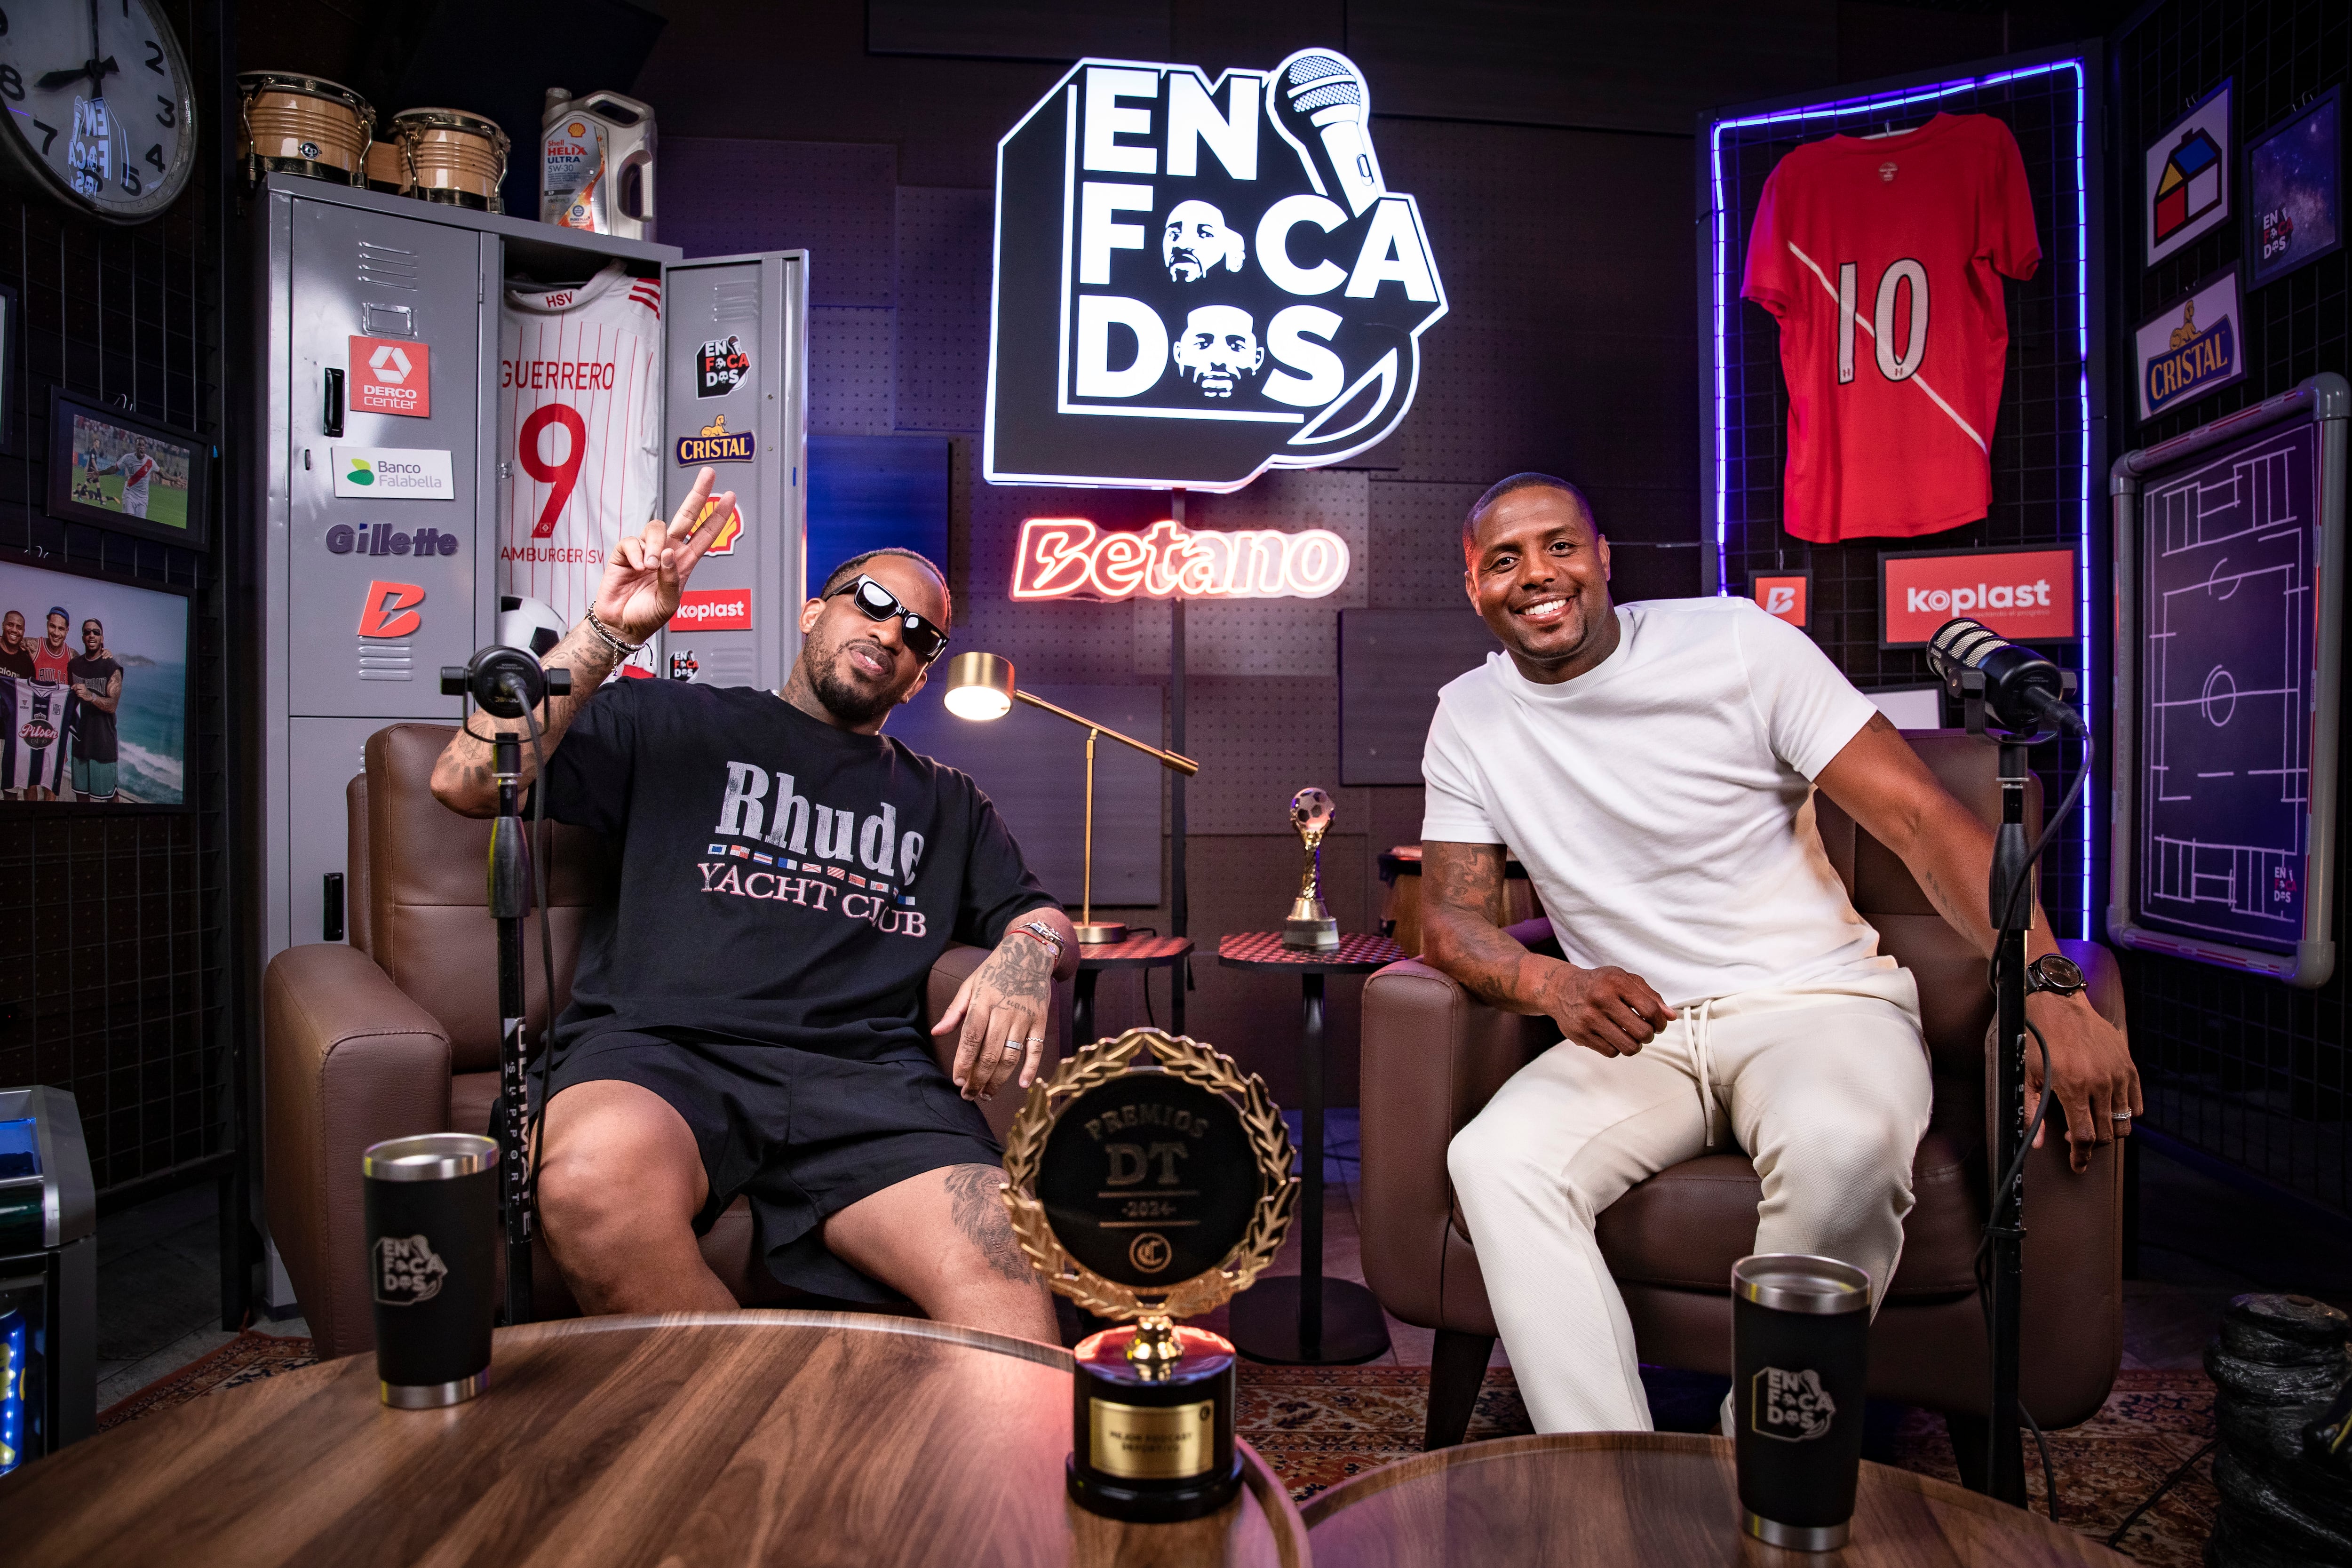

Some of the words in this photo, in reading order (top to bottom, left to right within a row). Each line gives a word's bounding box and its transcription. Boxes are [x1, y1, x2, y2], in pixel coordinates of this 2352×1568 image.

[144, 40, 165, 76] 2
[0, 64, 25, 101] 8
[156, 94, 175, 128] 3
[1083, 67, 1259, 180] EN
[33, 119, 58, 155] 7
[548, 143, 588, 156] HELIX
[145, 143, 166, 174] 4
[548, 164, 574, 173] 5W-30
[121, 162, 142, 197] 5
[546, 291, 573, 308] HSV
[1838, 258, 1930, 384] 10
[706, 341, 727, 357] EN
[502, 360, 614, 390] GUERRERO
[2151, 333, 2228, 400] CRISTAL
[364, 385, 417, 399] DERCO
[364, 396, 417, 409] center
[681, 437, 750, 460] CRISTAL
[378, 461, 421, 474] Banco
[379, 475, 442, 488] Falabella
[519, 404, 586, 538] 9
[326, 523, 458, 555] Gillette
[501, 547, 583, 563] AMBURGER
[1012, 517, 1347, 597] Betano
[676, 601, 744, 621] koplast
[1907, 579, 2050, 617] koplast
[675, 652, 687, 660] EN
[19, 724, 58, 739] Pilsen
[715, 761, 925, 886] Rhude
[697, 862, 837, 911] YACHT
[842, 893, 927, 938] CLUB
[509, 1061, 520, 1204] SUPPORT
[1084, 1104, 1209, 1142] PREMIOS
[1104, 1143, 1189, 1186] DT
[2015, 1083, 2025, 1227] SUPORT
